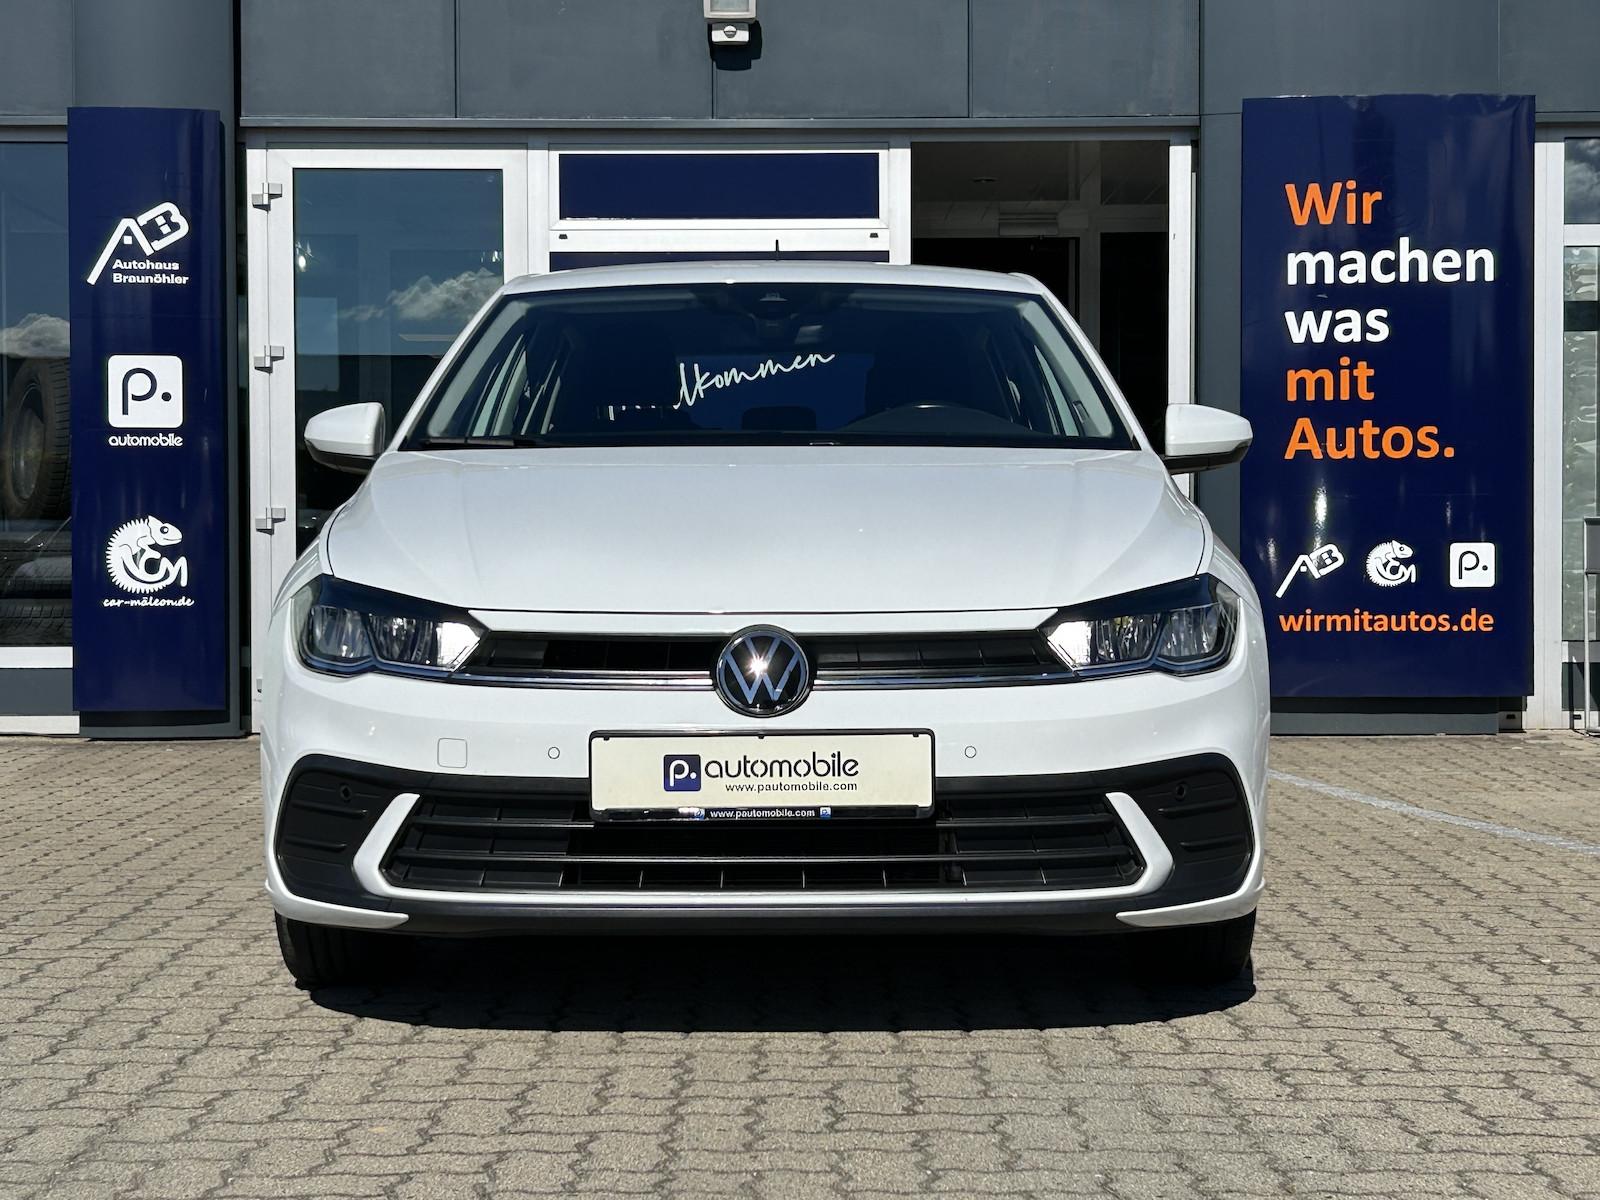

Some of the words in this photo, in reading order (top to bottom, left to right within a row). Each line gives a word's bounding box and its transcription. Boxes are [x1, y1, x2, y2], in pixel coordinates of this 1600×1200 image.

[1284, 179, 1383, 226] Wir
[112, 258, 180, 271] Autohaus
[1286, 236, 1496, 286] machen
[112, 272, 190, 285] Braunöhler
[1284, 307, 1390, 344] was
[1286, 356, 1375, 402] mit
[107, 433, 184, 448] automobile
[1283, 417, 1456, 460] Autos.
[1278, 607, 1495, 633] wirmitautos.de
[704, 751, 860, 779] automobile
[725, 781, 858, 794] www.pautomobile.com
[710, 808, 816, 820] www.pautomobile.com
